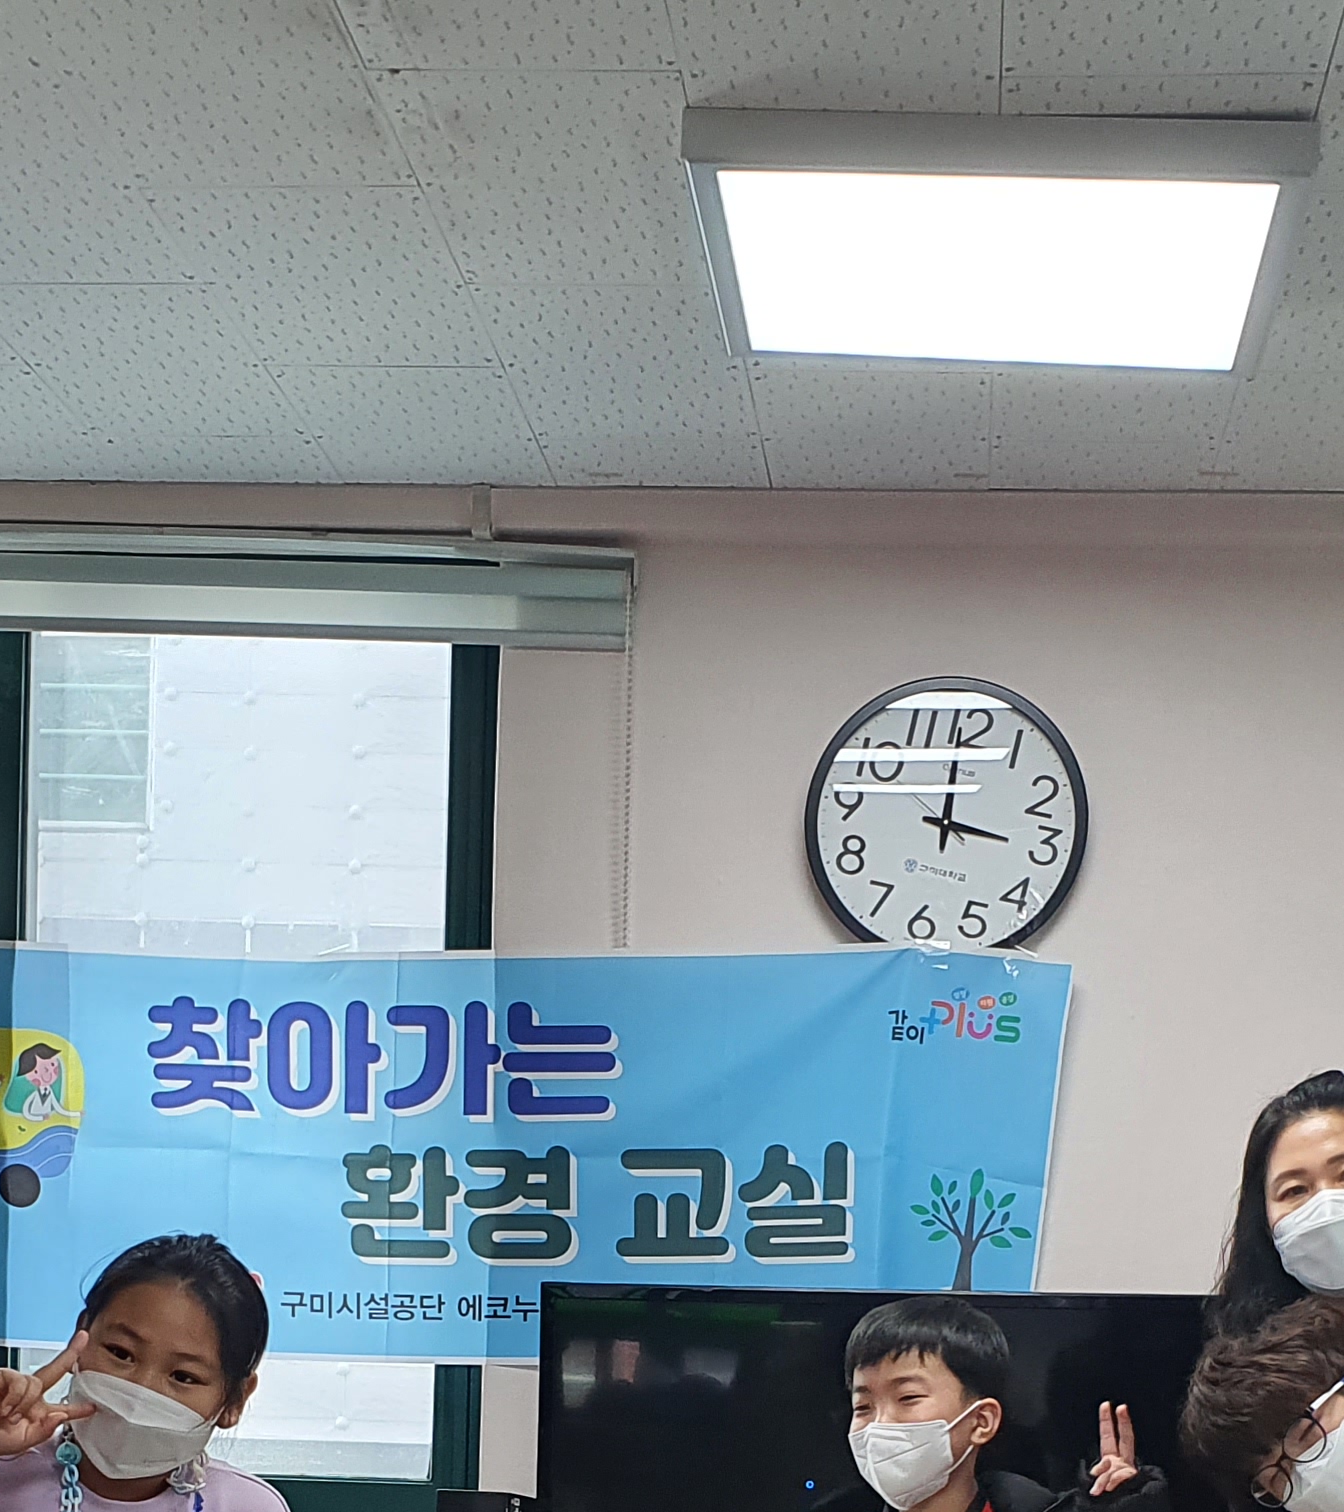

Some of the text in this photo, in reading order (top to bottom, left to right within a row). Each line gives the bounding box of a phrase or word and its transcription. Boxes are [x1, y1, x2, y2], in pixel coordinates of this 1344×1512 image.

[906, 708, 938, 748] 11
[947, 708, 994, 749] 12
[856, 737, 905, 782] 10
[1009, 729, 1024, 769] 1
[833, 782, 864, 821] 9
[1024, 775, 1060, 819] 2
[836, 834, 866, 875] 8
[1028, 825, 1063, 866] 3
[869, 880, 895, 918] 7
[999, 877, 1031, 913] 4
[907, 904, 936, 940] 6
[957, 900, 989, 939] 5
[888, 1010, 925, 1044] 같이
[147, 996, 621, 1119] 찾아가는
[341, 1142, 854, 1263] 환경 교실
[280, 1291, 446, 1323] 구미시설공단
